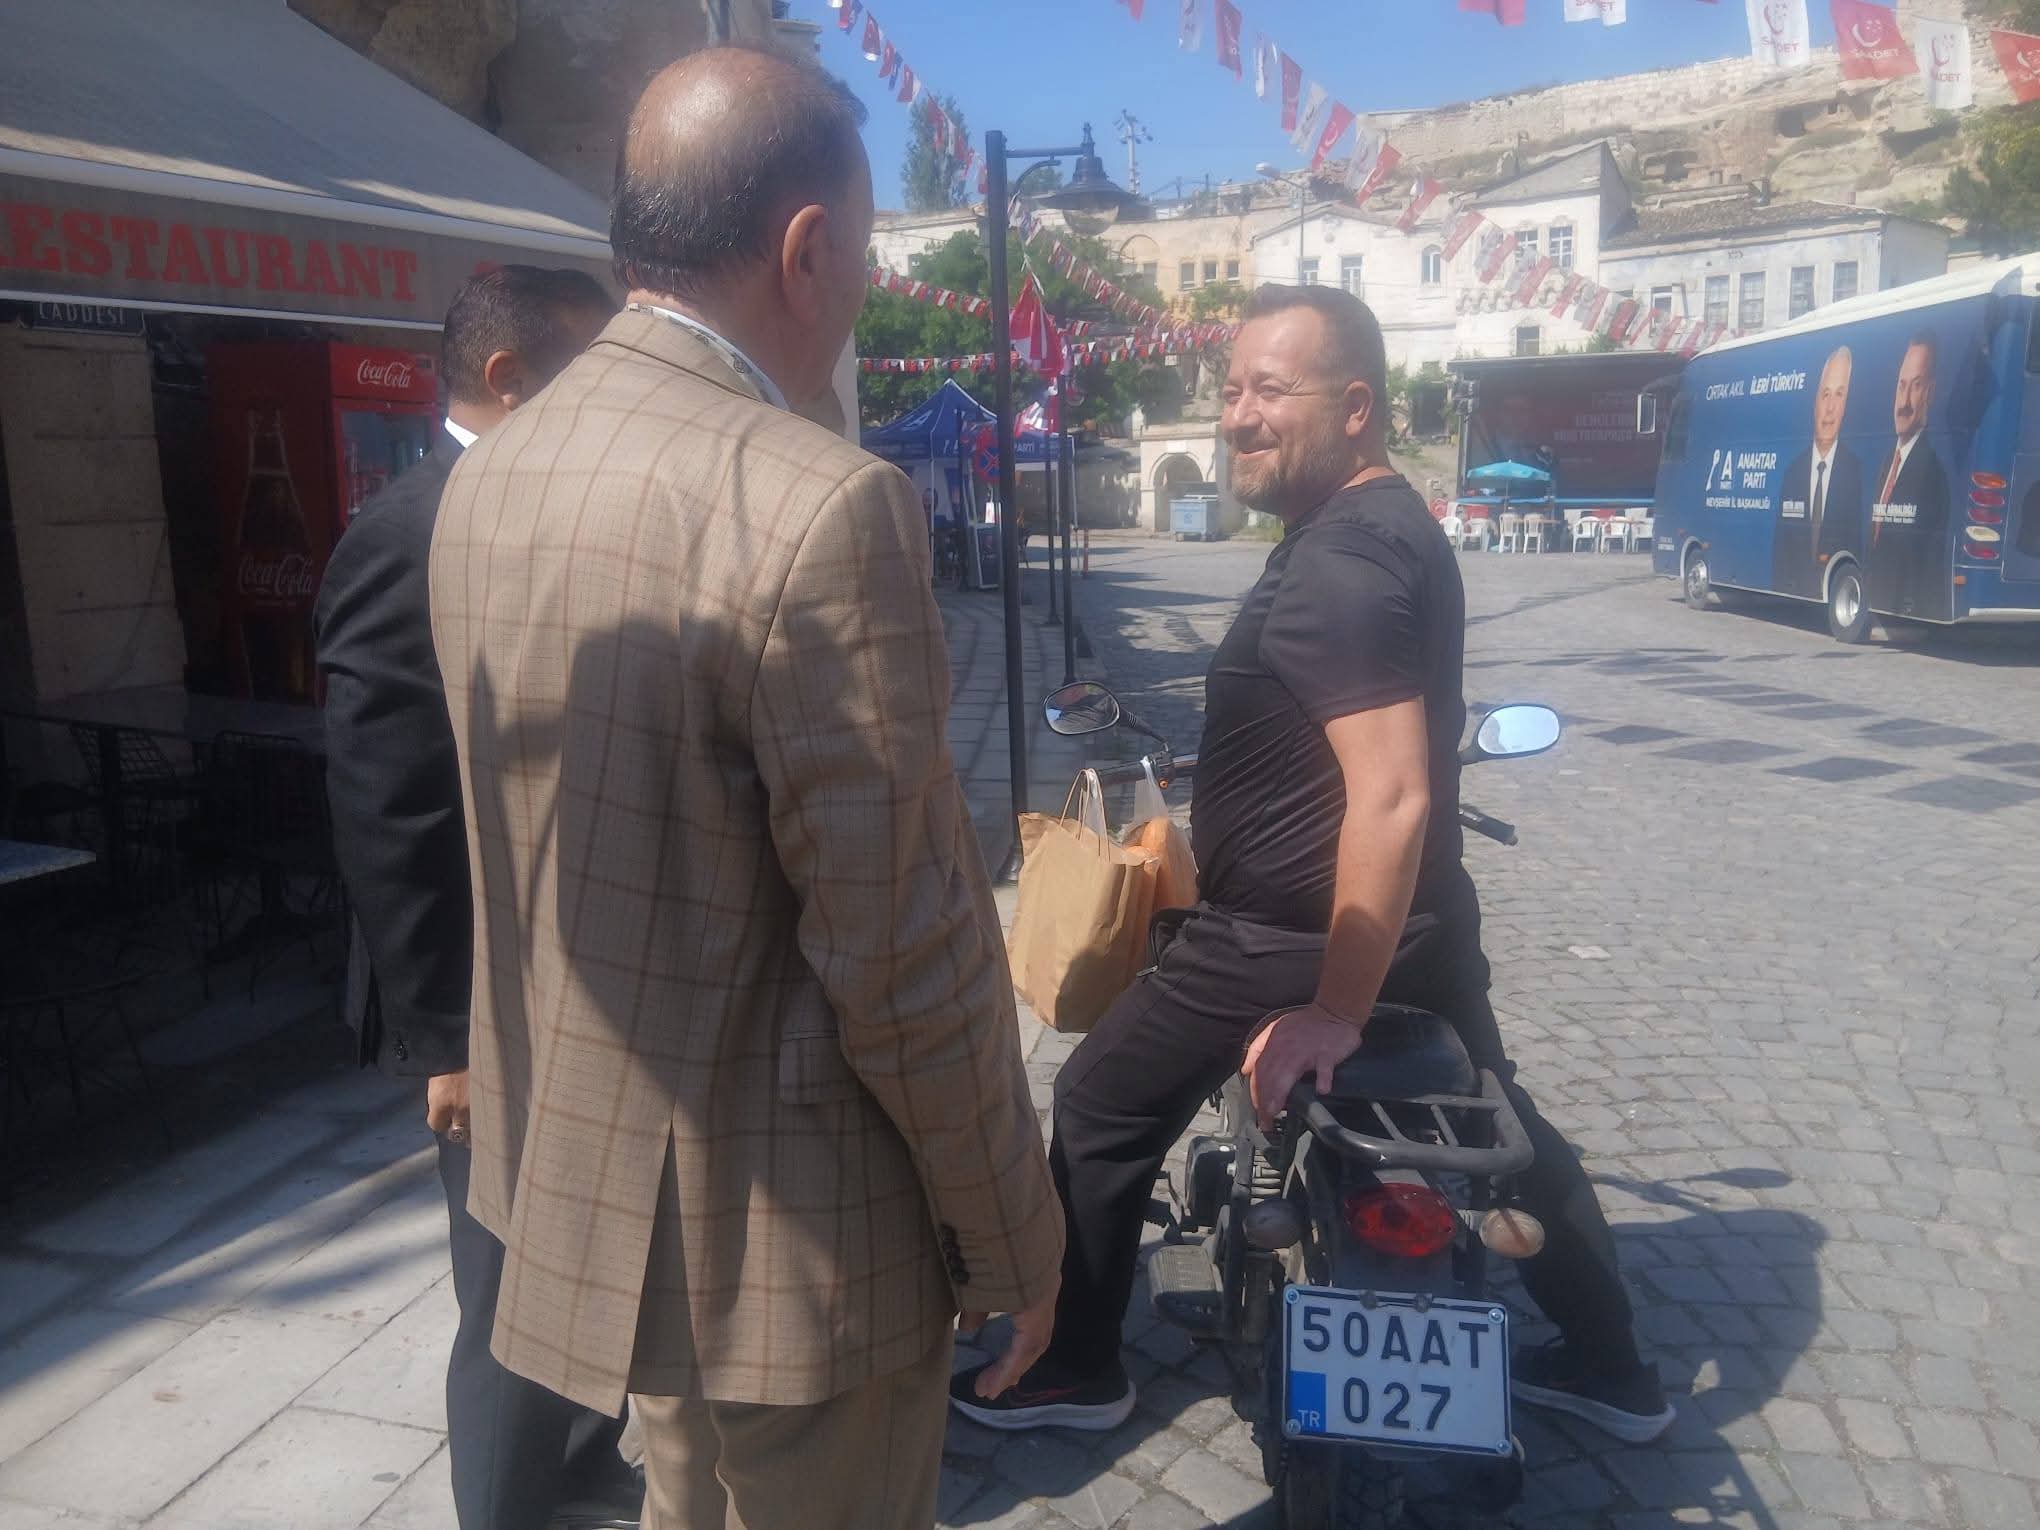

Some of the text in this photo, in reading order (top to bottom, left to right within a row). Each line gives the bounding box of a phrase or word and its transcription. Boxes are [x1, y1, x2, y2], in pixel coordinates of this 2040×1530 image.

[0, 201, 417, 301] ESTAURANT
[357, 359, 411, 388] Coca-Cola
[1706, 384, 1728, 401] ORTAK
[1728, 380, 1745, 396] AKIL
[1770, 370, 1807, 392] TÜRKİYE
[1737, 452, 1777, 470] ANAHTAR
[1743, 472, 1767, 489] PARTİ
[1298, 1409, 1320, 1428] TR
[1343, 1377, 1451, 1431] 027
